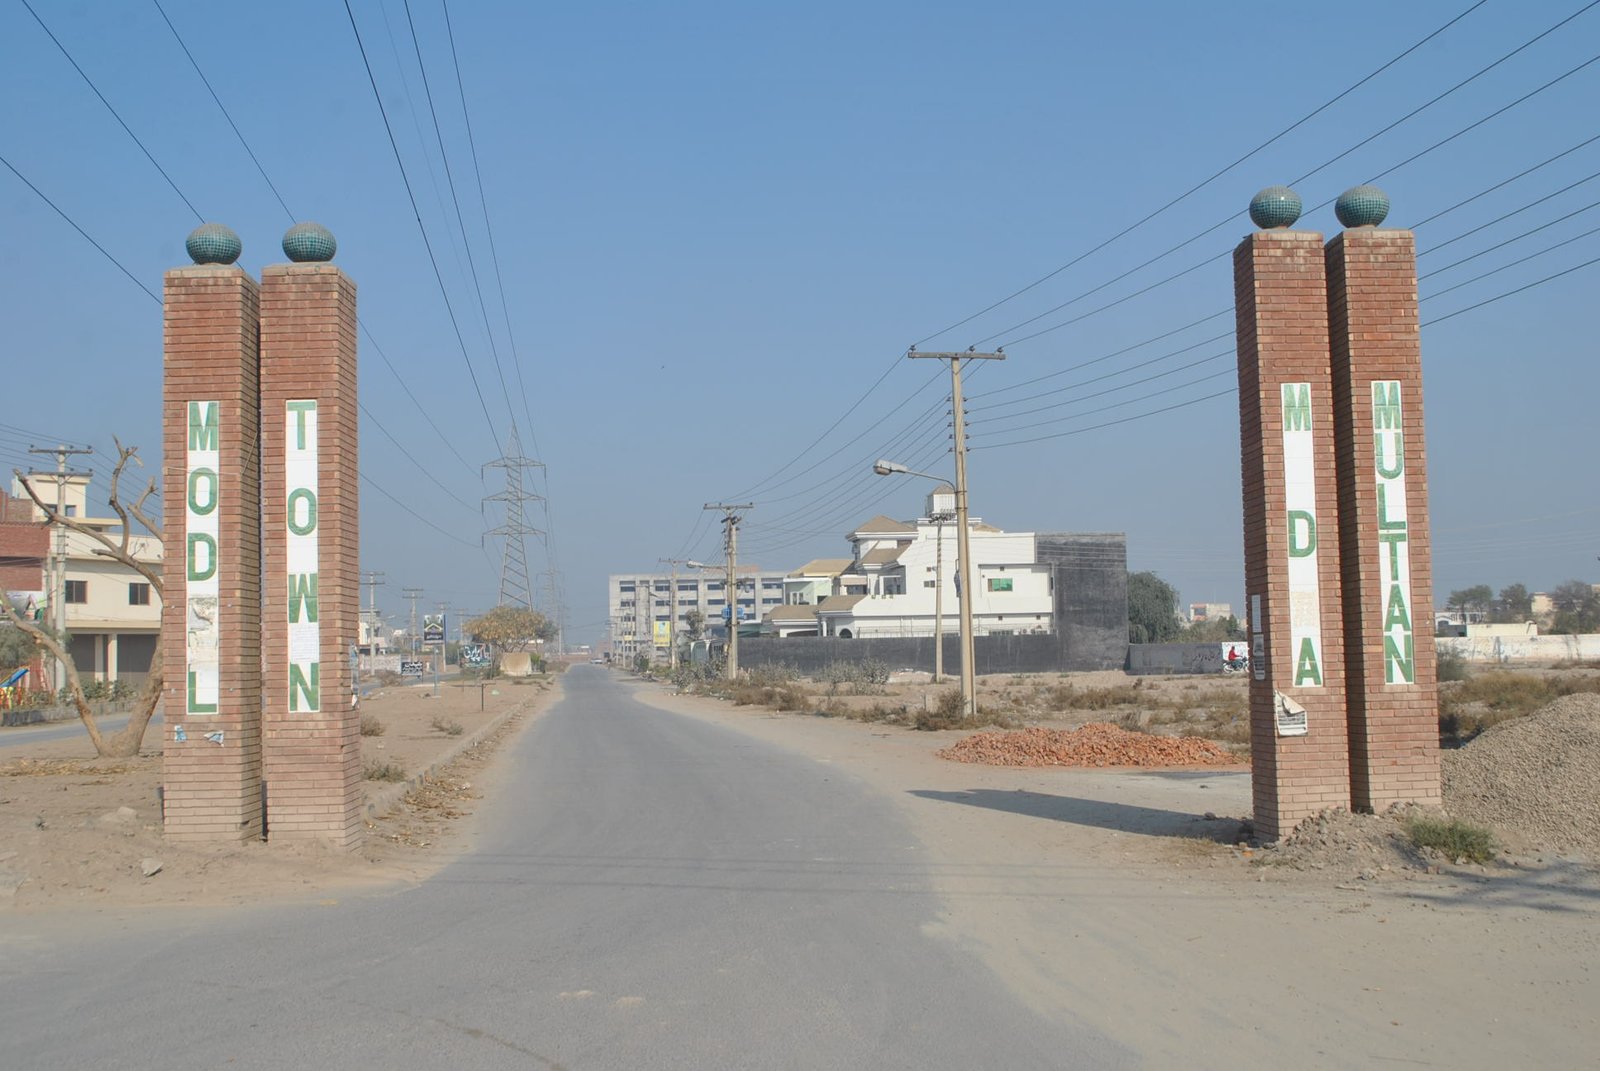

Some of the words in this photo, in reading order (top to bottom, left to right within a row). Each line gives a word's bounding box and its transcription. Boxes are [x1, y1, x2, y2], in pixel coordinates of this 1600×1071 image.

[188, 401, 218, 713] MODL
[286, 402, 319, 711] TOWN
[1373, 381, 1414, 683] MULTAN
